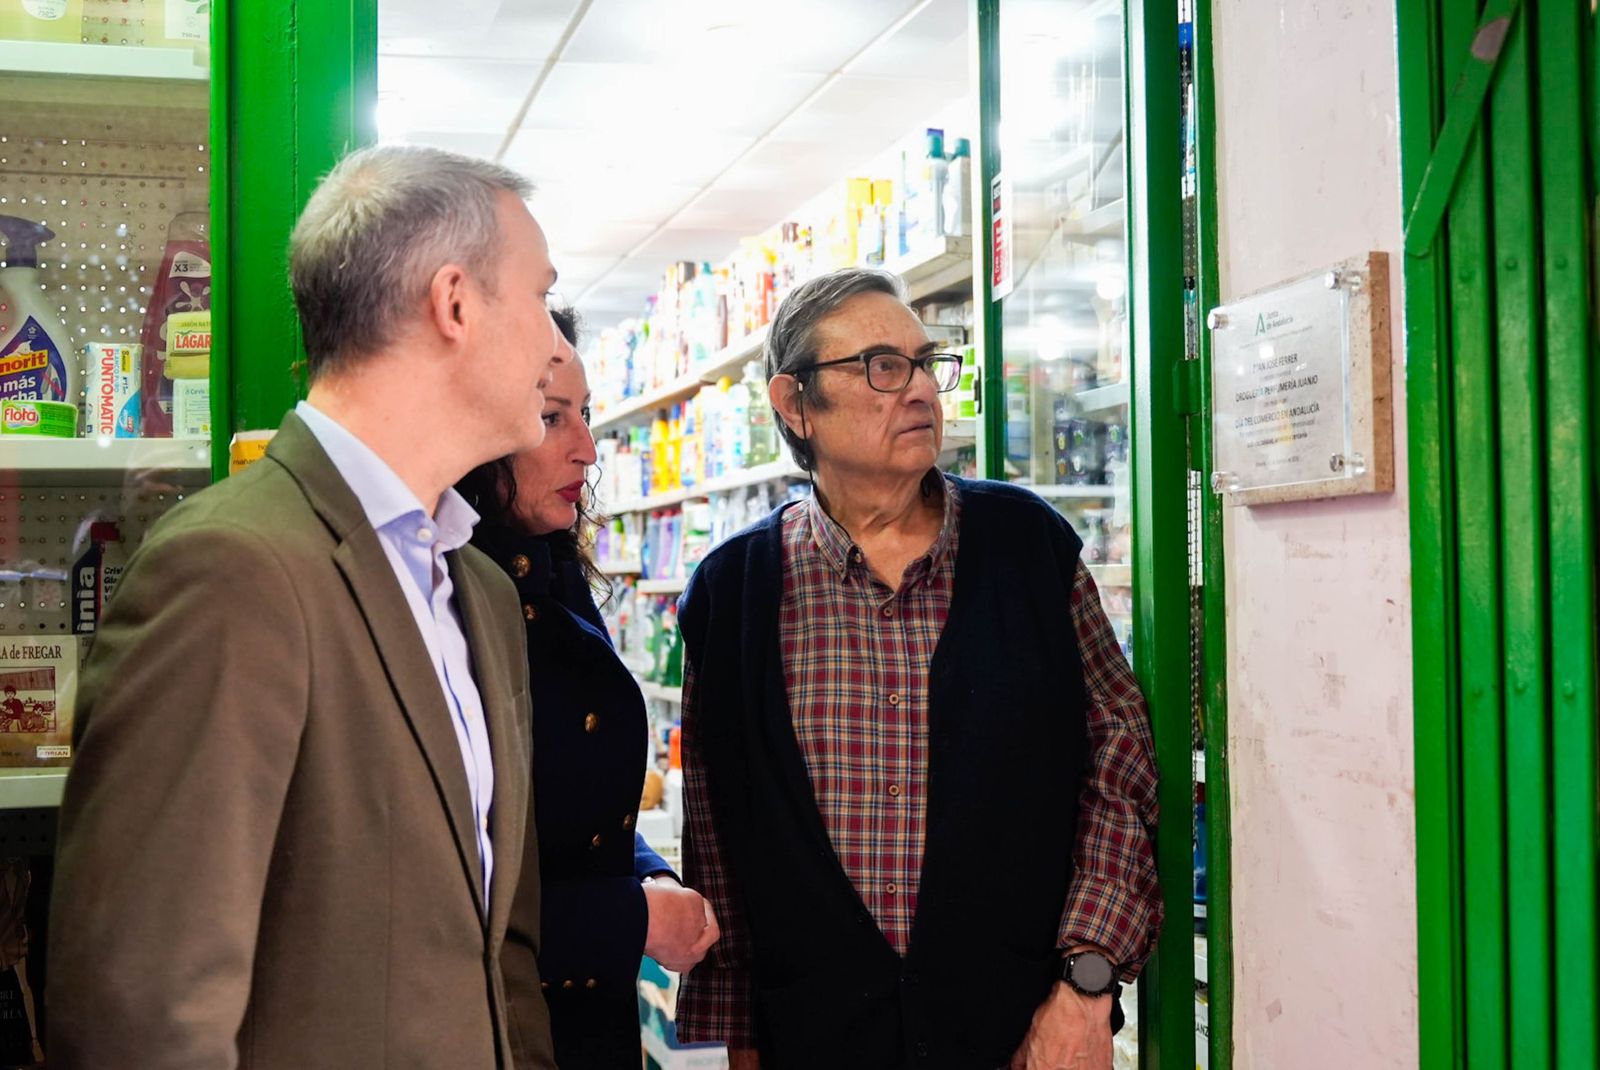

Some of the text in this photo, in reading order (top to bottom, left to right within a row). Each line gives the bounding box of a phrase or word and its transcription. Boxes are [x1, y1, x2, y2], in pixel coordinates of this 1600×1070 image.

[174, 264, 188, 272] X3
[1279, 353, 1299, 368] FERRER
[3, 375, 37, 393] más
[101, 348, 114, 435] PUNTOMATIC
[1289, 401, 1321, 418] ANDALUCÍA
[10, 644, 20, 660] de
[22, 645, 62, 660] FREGAR
